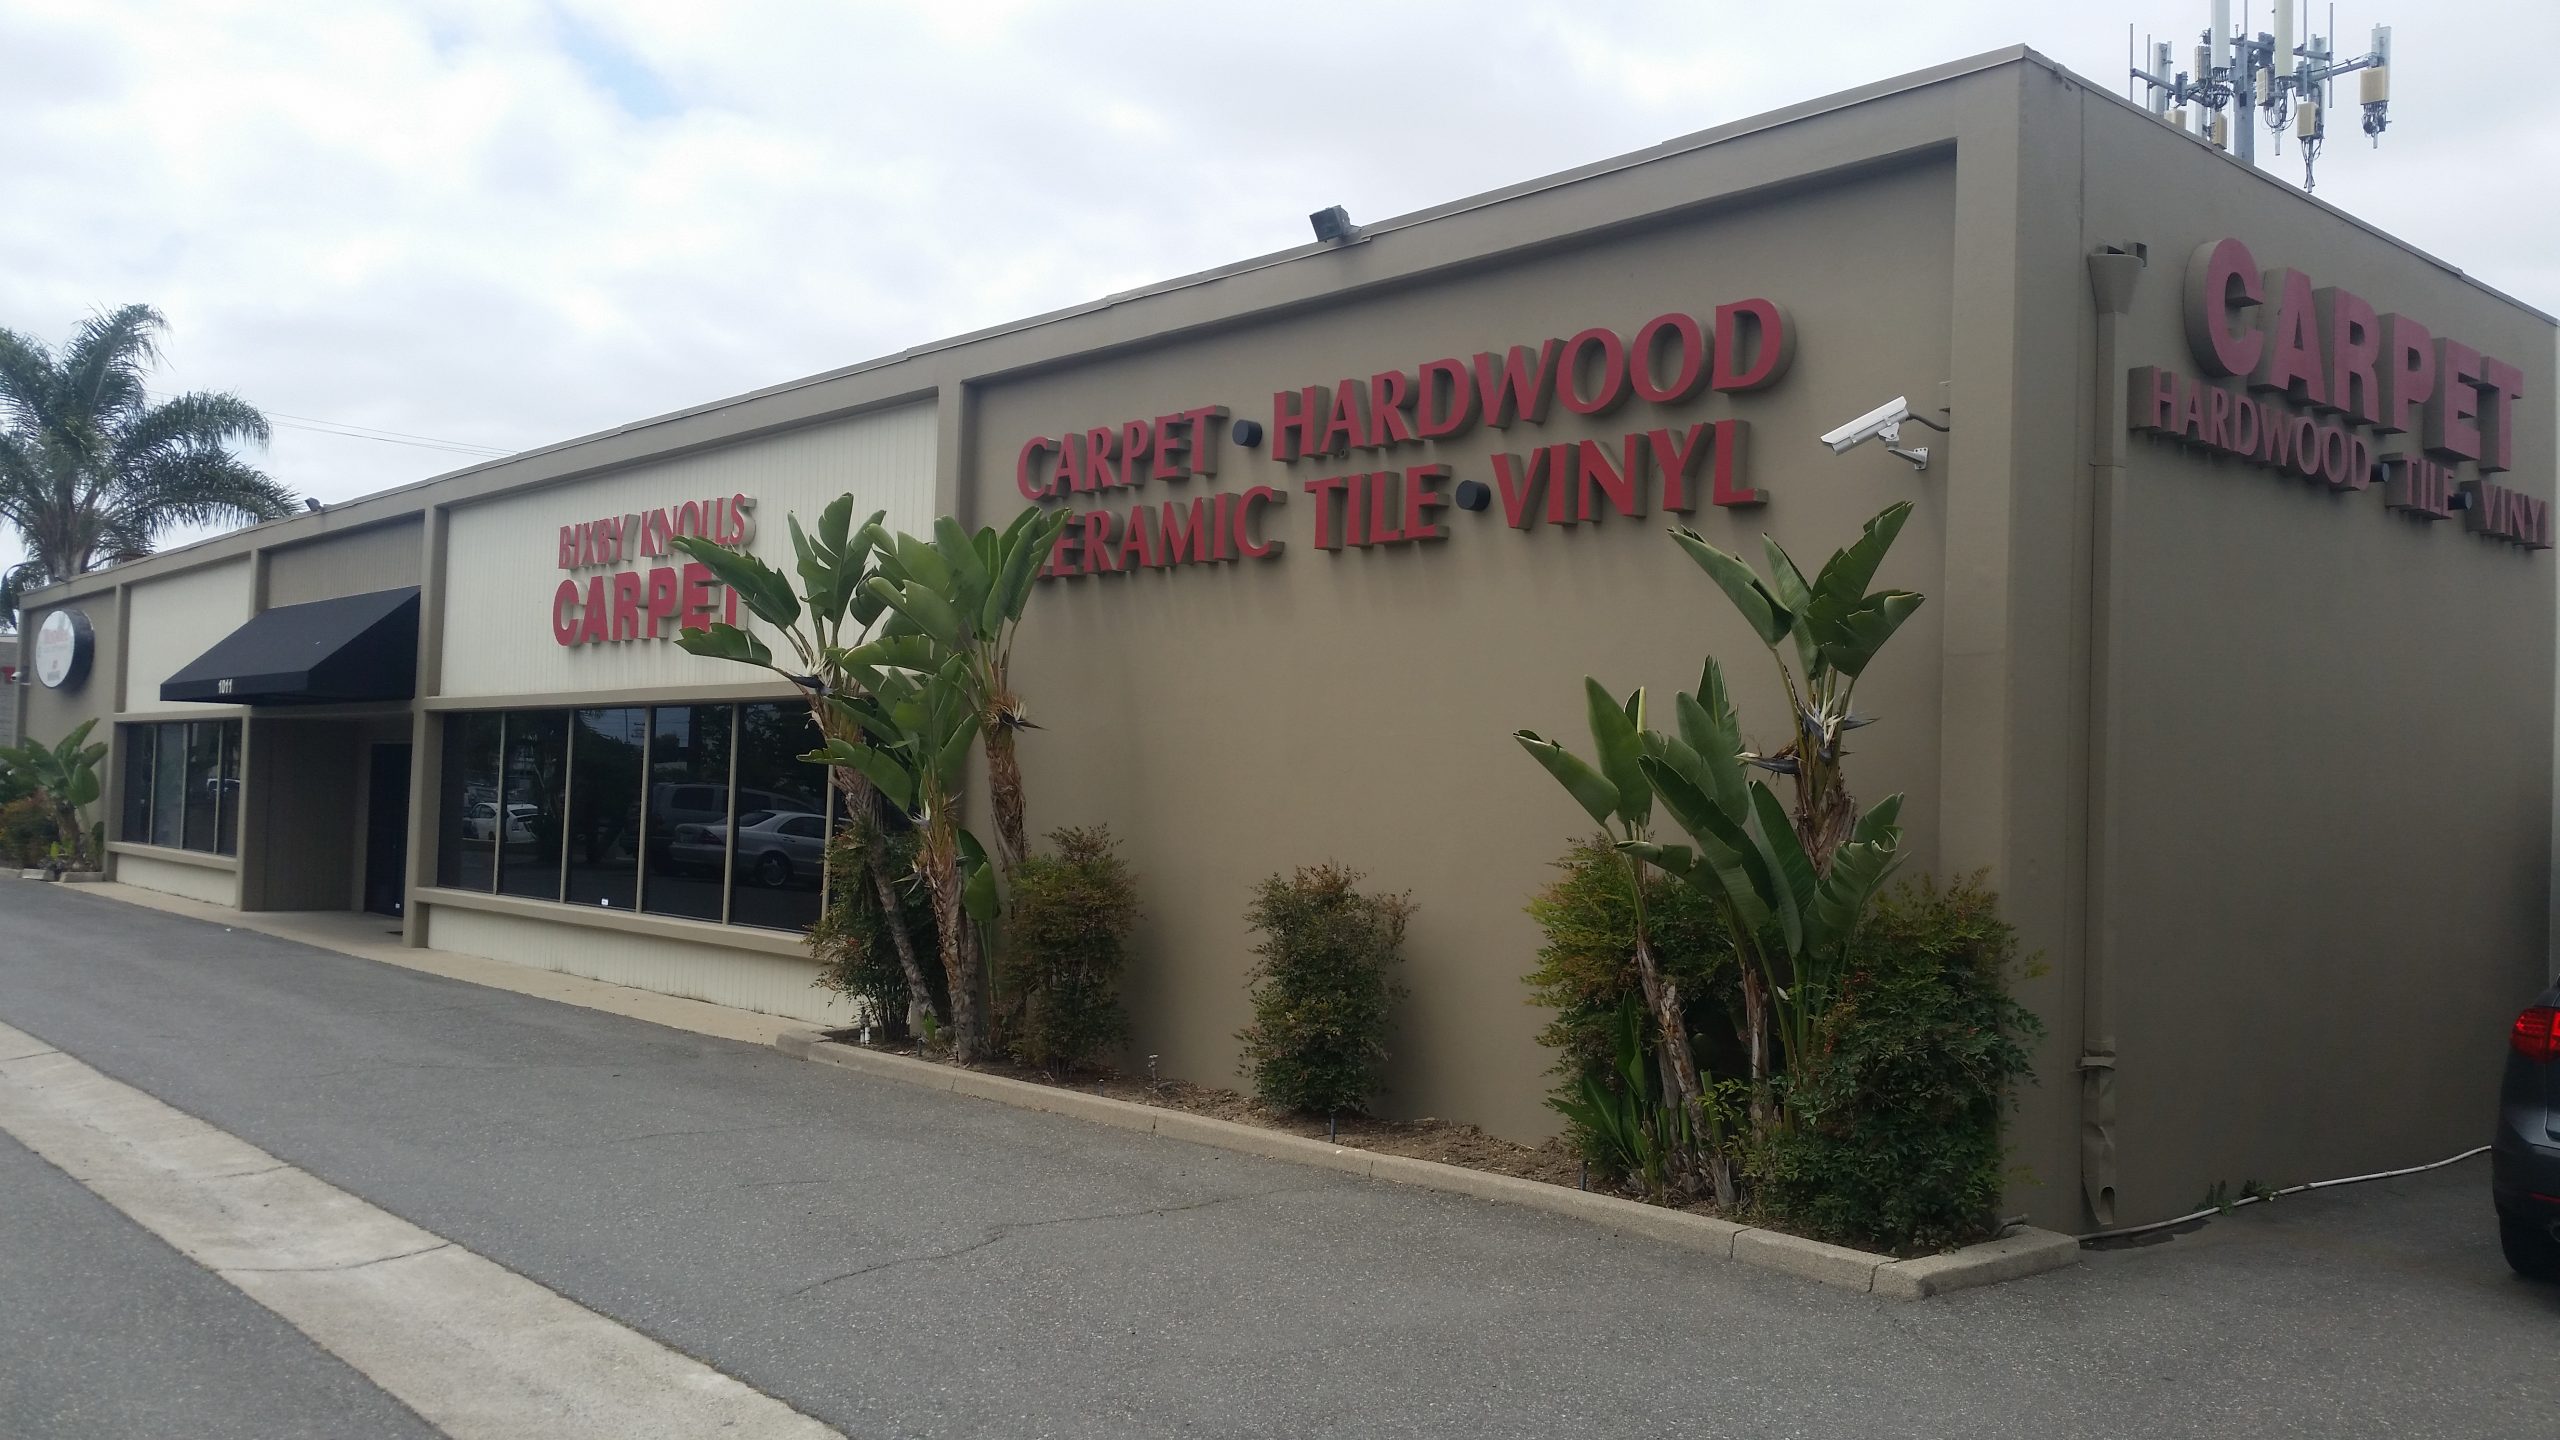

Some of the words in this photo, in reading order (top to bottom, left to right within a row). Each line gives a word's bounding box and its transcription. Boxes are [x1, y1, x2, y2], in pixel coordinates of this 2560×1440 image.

[1017, 404, 1222, 500] CARPET
[1272, 298, 1787, 461] HARDWOOD
[2203, 238, 2523, 471] CARPET
[559, 514, 634, 569] BIXBY
[1037, 485, 1277, 578] ERAMIC
[1305, 464, 1448, 551] TILE
[1491, 419, 1762, 529] VINYL
[2146, 366, 2371, 490] HARDWOOD
[2400, 452, 2454, 519] TILE
[2480, 480, 2552, 549] VINYL
[218, 679, 233, 694] 1011
